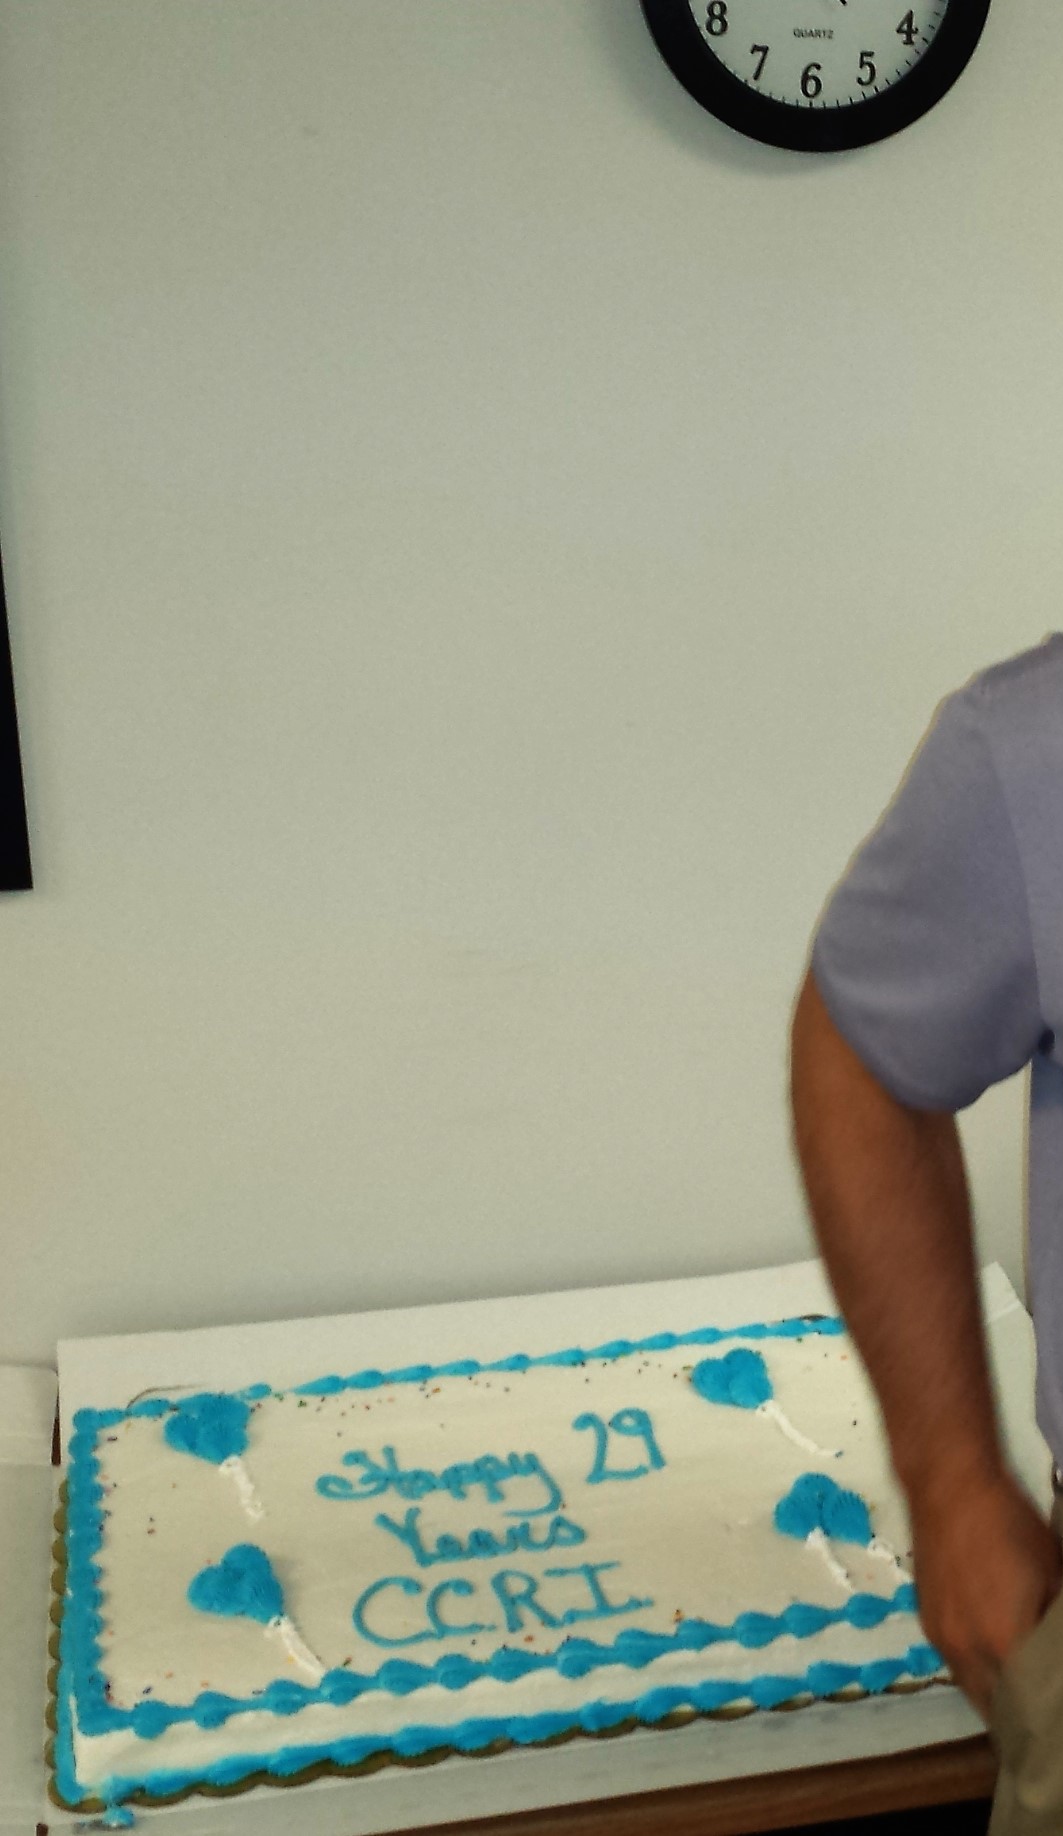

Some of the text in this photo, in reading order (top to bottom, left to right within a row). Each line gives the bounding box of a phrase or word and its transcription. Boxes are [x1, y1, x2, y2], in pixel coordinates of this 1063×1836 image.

[706, 0, 728, 36] 8
[793, 28, 834, 39] QUARTZ
[896, 9, 918, 45] 4
[750, 44, 769, 81] 7
[801, 62, 822, 98] 6
[857, 51, 876, 86] 5
[315, 1408, 667, 1517] Happy 29
[374, 1507, 587, 1568] Years
[352, 1560, 655, 1648] CCRI
